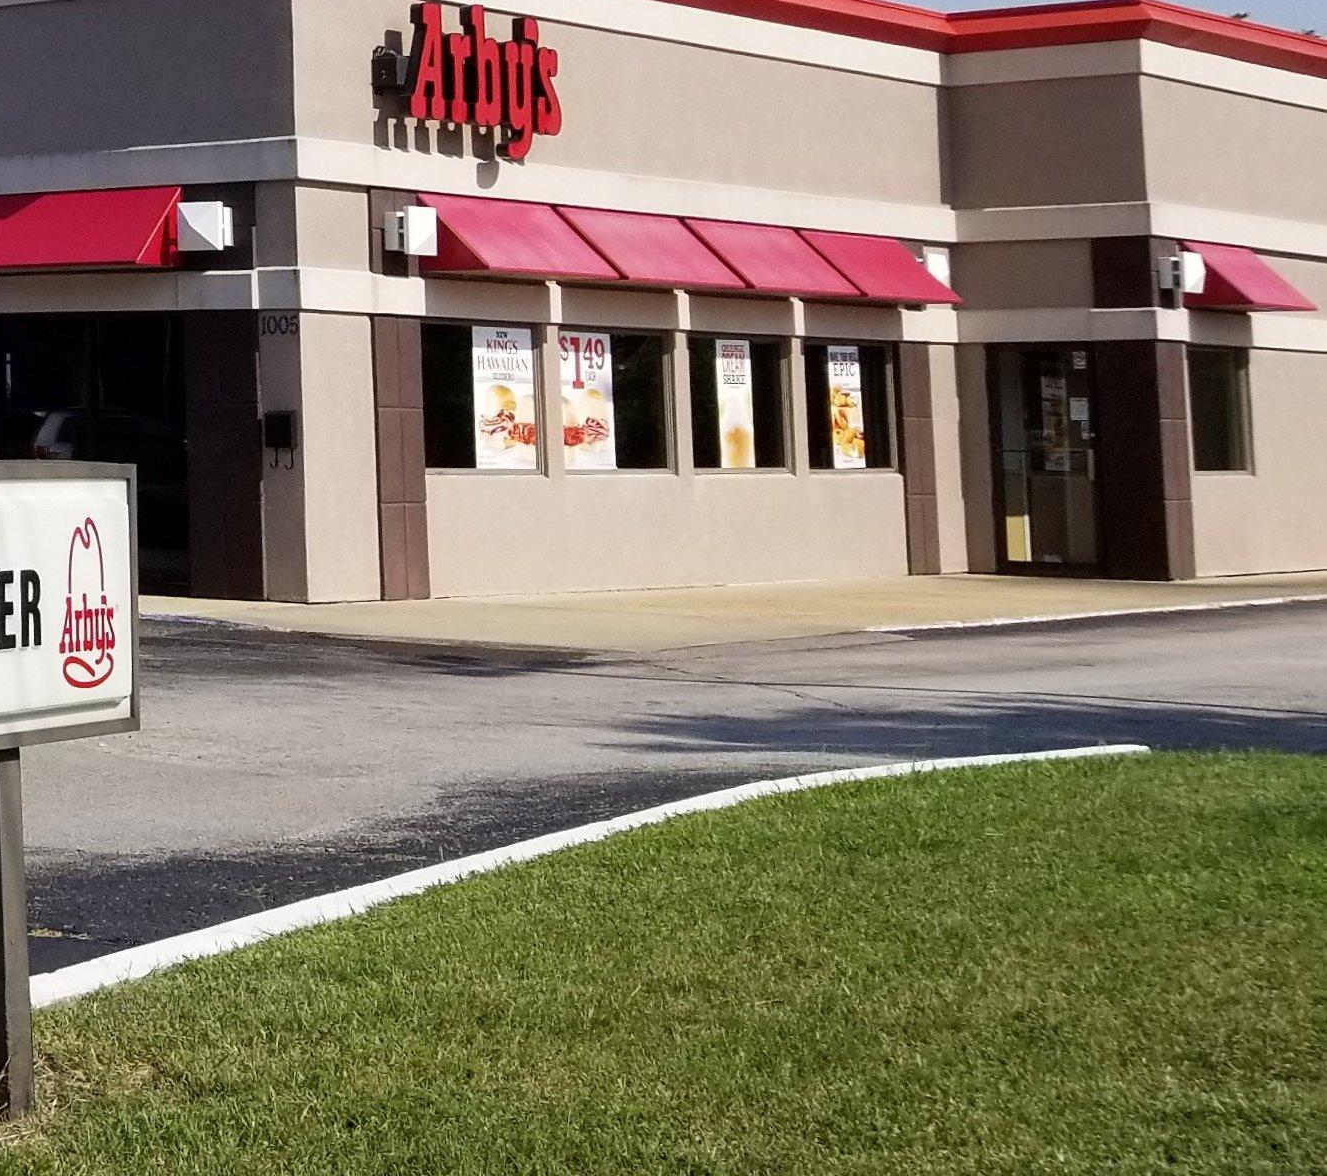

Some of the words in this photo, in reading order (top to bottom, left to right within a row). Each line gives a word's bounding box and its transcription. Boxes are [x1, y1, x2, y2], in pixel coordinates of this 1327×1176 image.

[410, 1, 563, 160] Arby's
[261, 315, 299, 334] 1005
[833, 362, 855, 377] EPIC
[58, 592, 117, 665] Arby's
